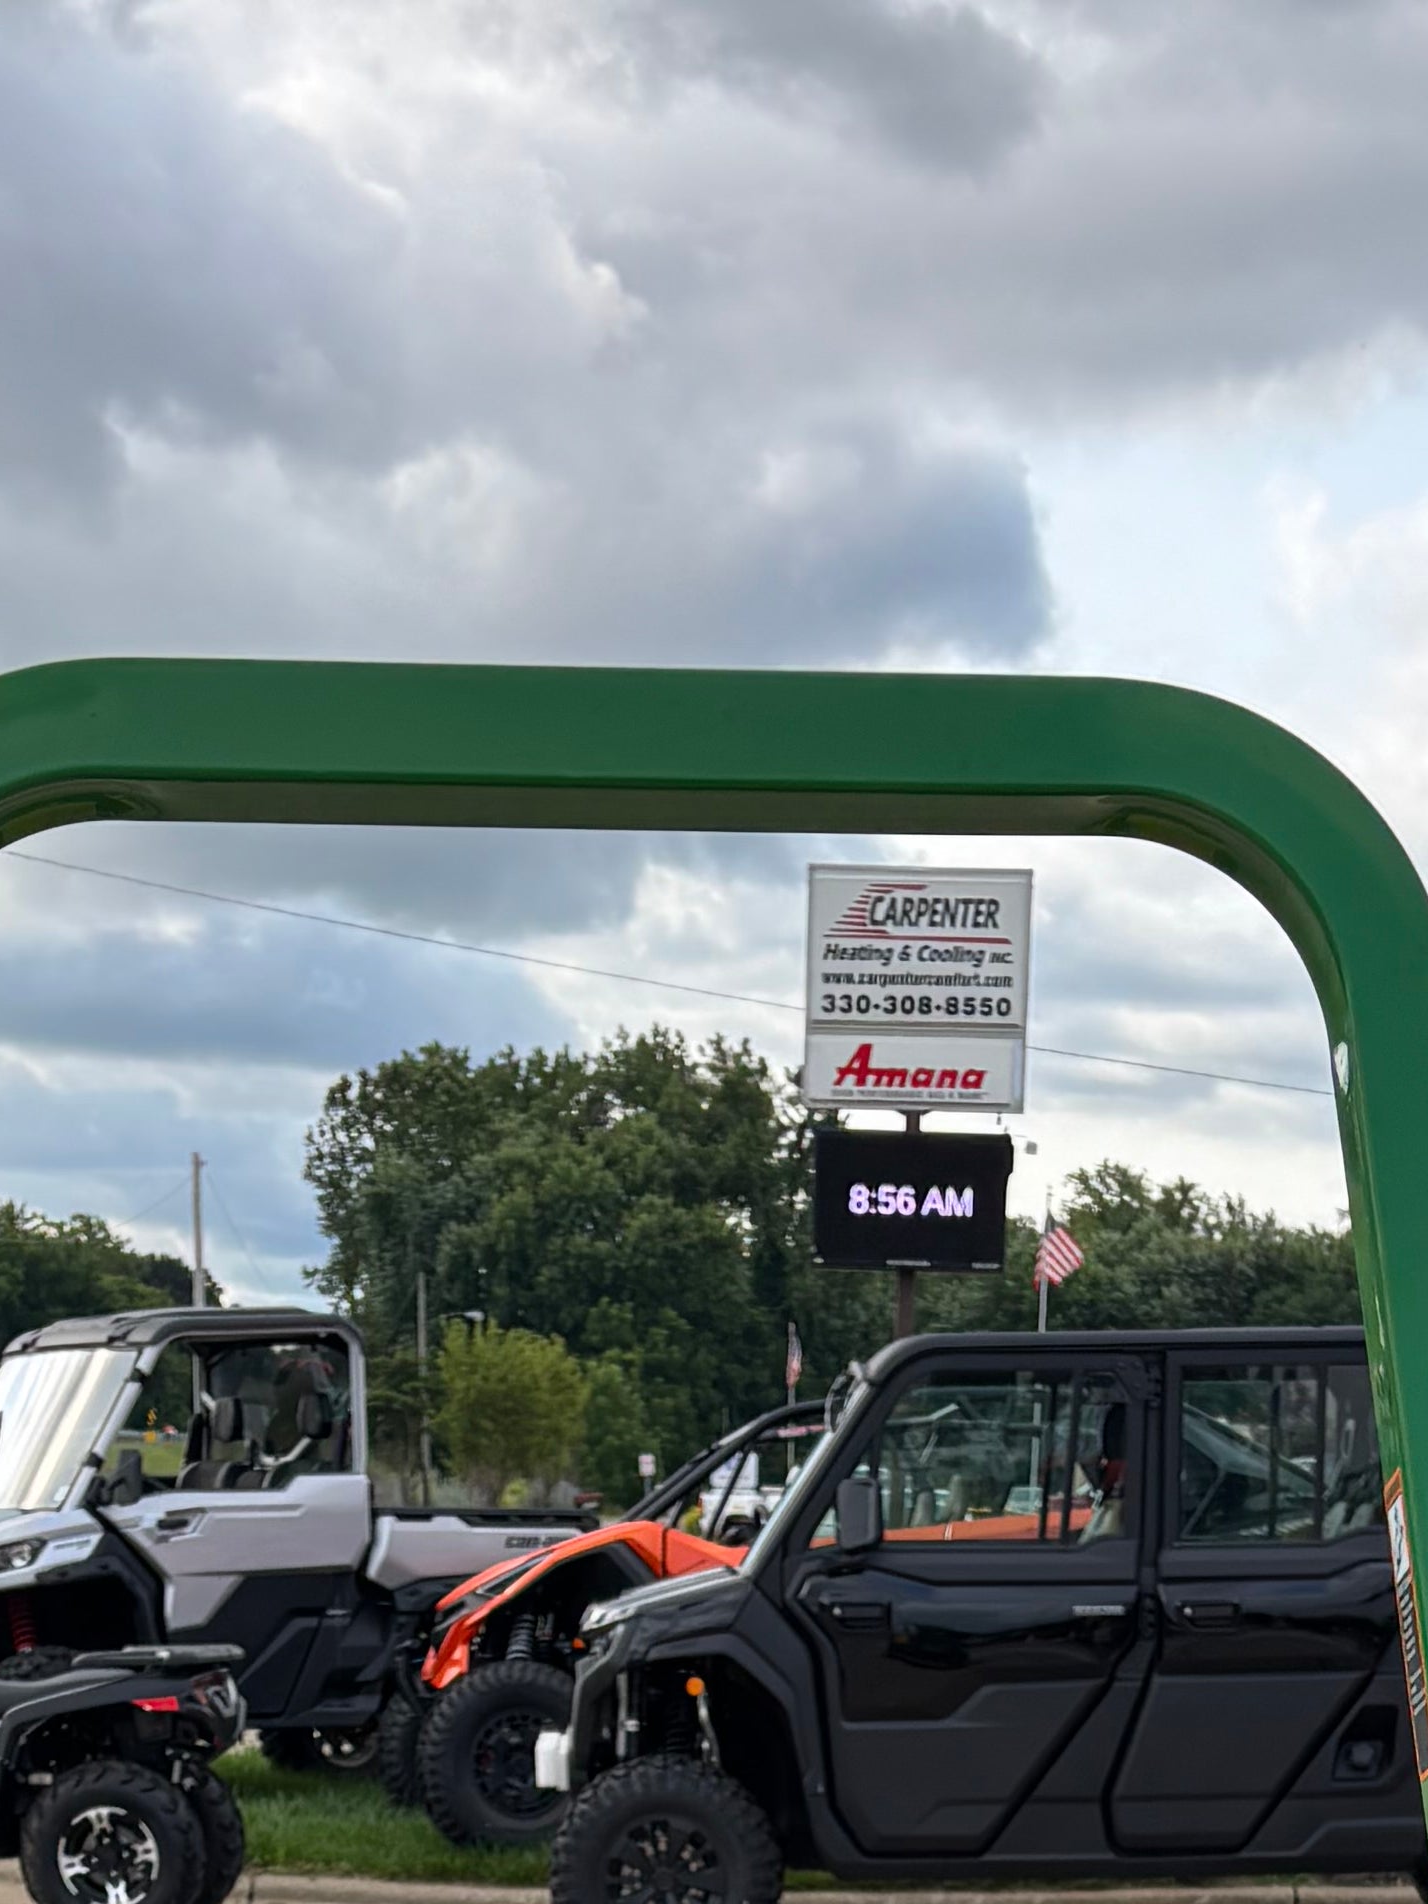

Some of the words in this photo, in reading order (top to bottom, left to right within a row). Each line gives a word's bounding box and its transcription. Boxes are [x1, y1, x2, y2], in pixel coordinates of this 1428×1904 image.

[869, 895, 1000, 929] CARPENTER
[823, 943, 894, 966] Heating
[898, 944, 912, 962] &
[917, 944, 986, 968] Cooling
[833, 1043, 988, 1089] Amana
[848, 1183, 916, 1216] 8:56
[920, 1184, 974, 1218] AM
